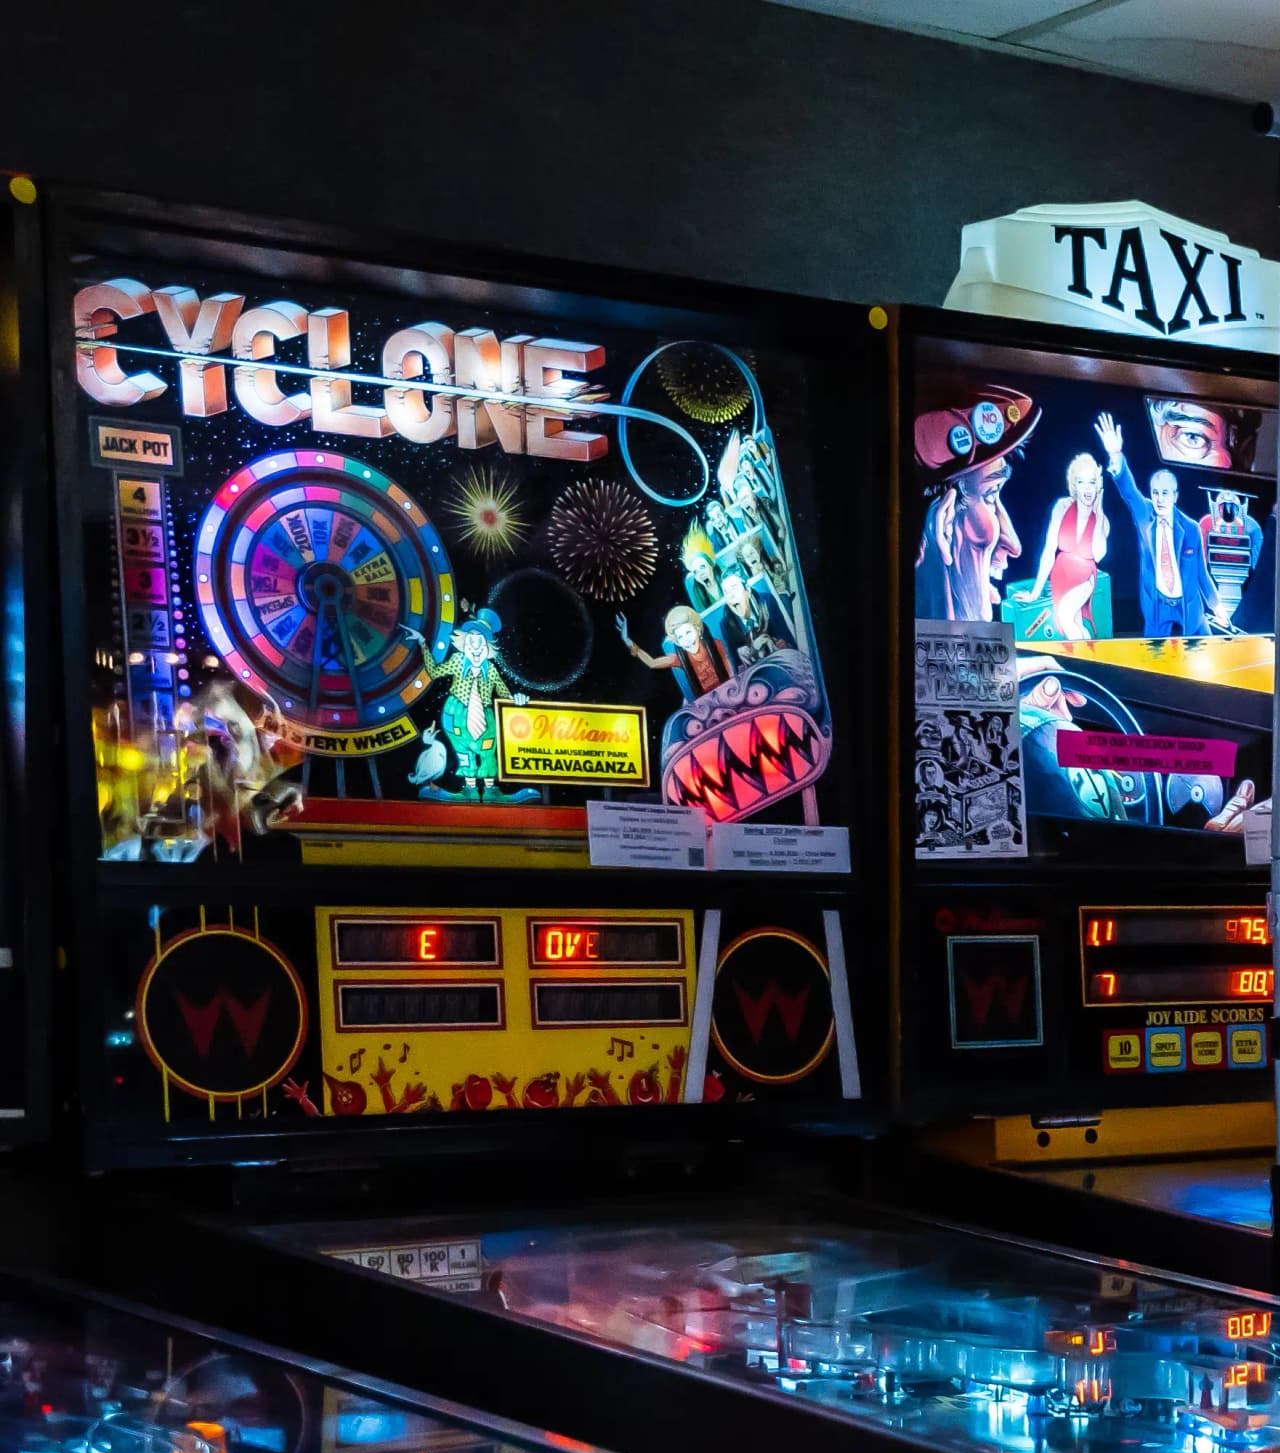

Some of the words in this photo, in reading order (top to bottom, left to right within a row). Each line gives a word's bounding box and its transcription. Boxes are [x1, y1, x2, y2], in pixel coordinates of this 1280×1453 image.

[1054, 223, 1246, 335] TAXI
[74, 278, 609, 462] CYCLONE
[102, 435, 138, 455] JACK
[143, 440, 170, 457] POT
[132, 486, 146, 504] 4
[313, 519, 329, 547] 10K
[353, 725, 411, 750] WHEEL
[533, 714, 631, 744] Williams
[518, 746, 551, 755] PINBALL
[554, 748, 605, 757] AMUSEMENT
[511, 757, 637, 774] EXTRAVAGANZA
[420, 930, 437, 959] E
[1145, 1008, 1172, 1026] JOY
[1174, 1009, 1208, 1025] RIDE
[1211, 1007, 1265, 1023] SCORES
[1118, 1040, 1132, 1056] 10
[424, 1250, 446, 1263] 100
